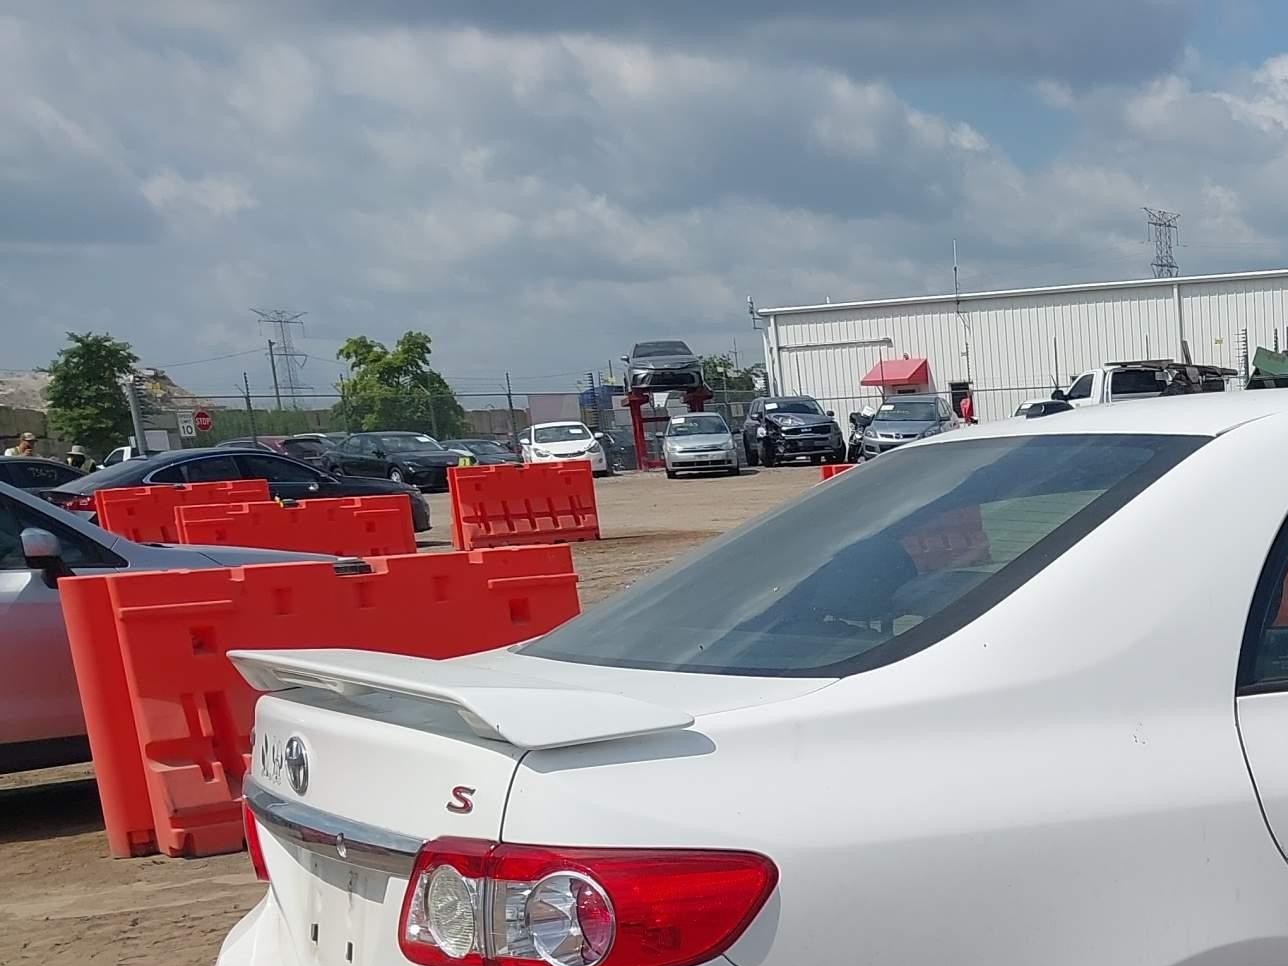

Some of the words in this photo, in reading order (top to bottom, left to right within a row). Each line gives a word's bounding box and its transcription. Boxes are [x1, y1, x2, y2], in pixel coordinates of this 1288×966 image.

[195, 417, 210, 425] STOP
[182, 425, 193, 435] 10
[446, 786, 476, 814] S
